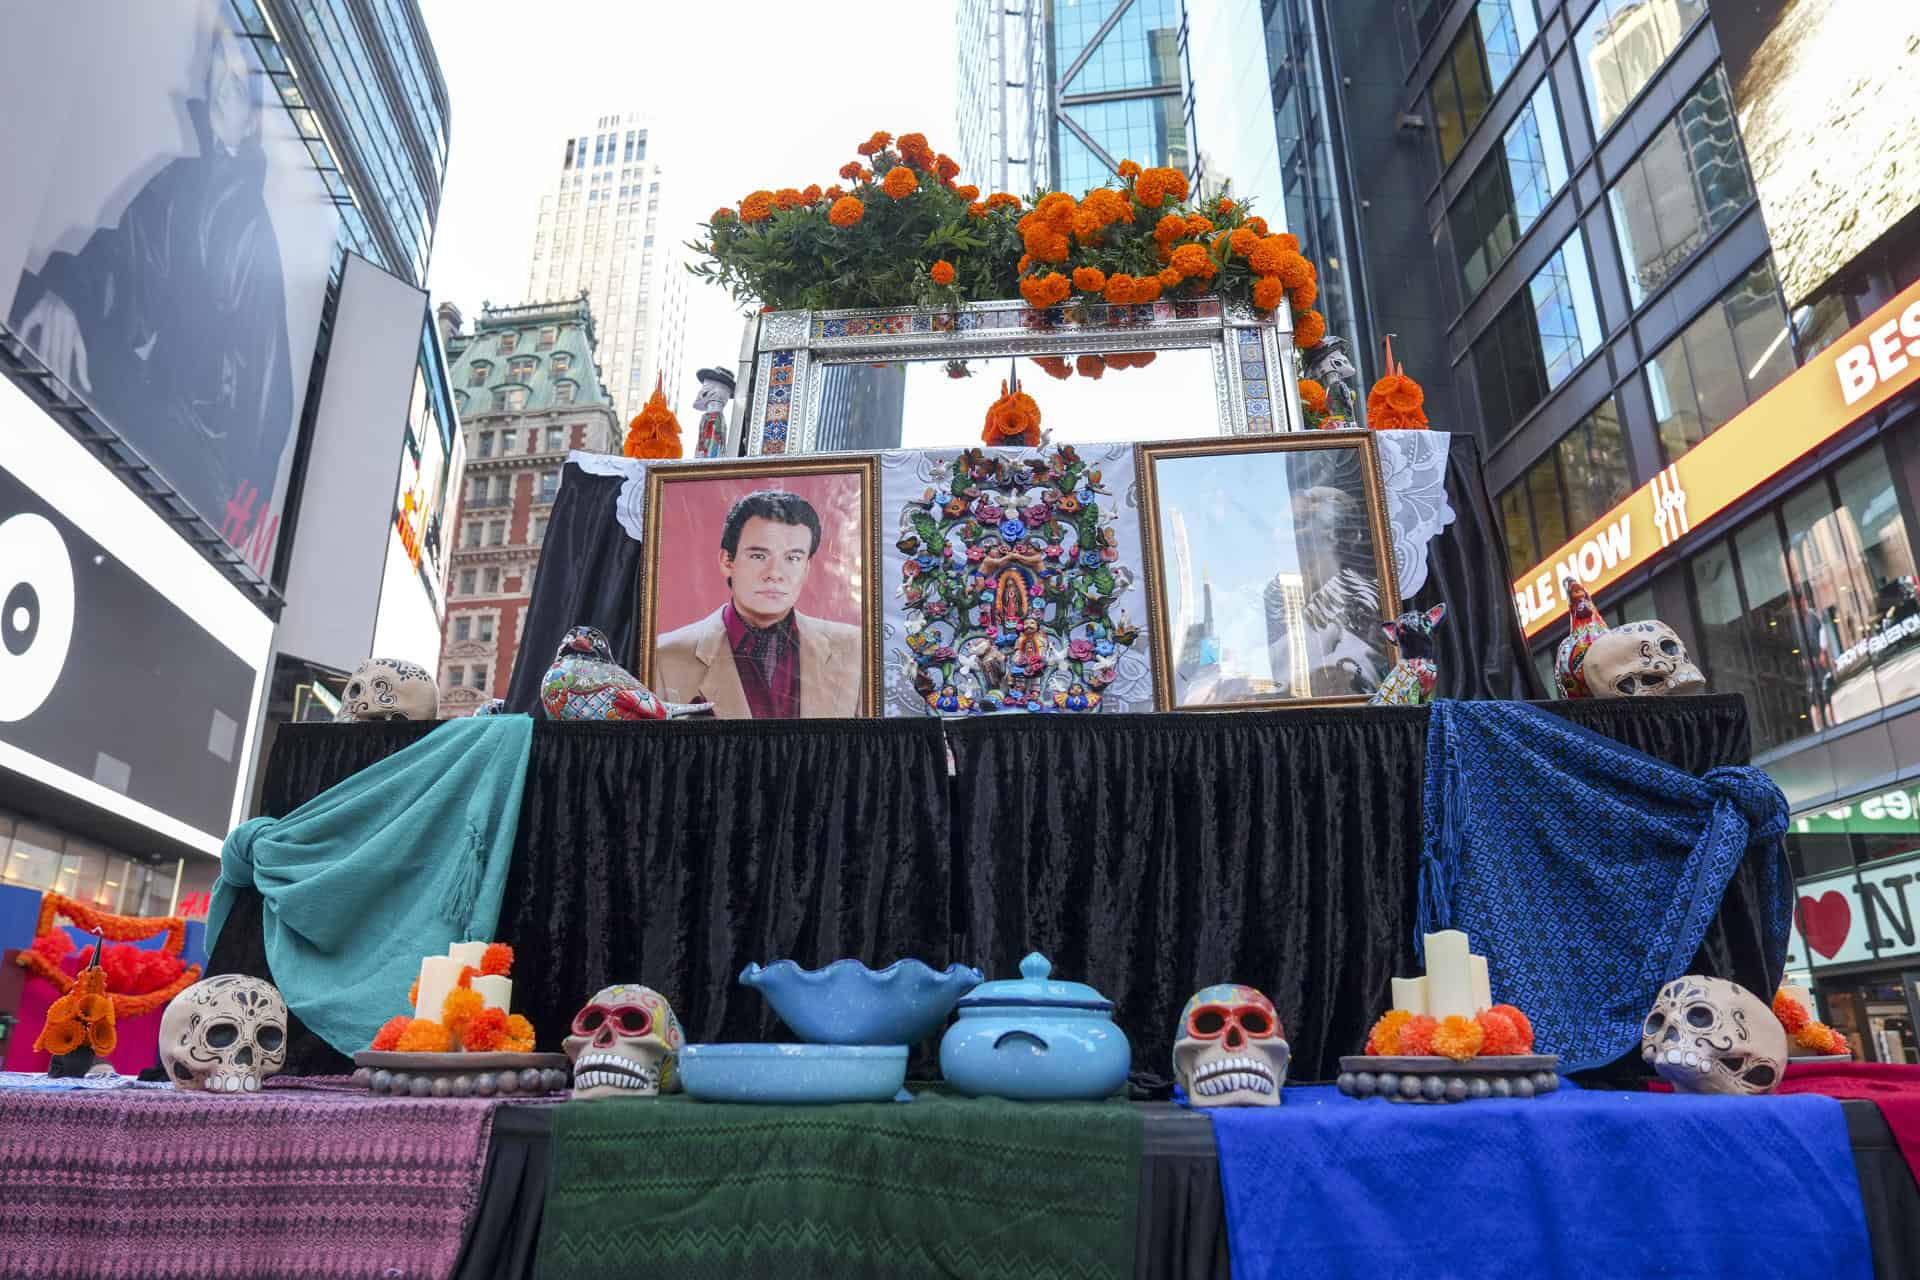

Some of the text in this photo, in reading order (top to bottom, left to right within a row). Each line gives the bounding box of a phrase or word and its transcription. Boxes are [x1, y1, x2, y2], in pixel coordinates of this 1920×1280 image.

[220, 479, 280, 577] H&M
[1555, 513, 1631, 601] NOW
[1852, 871, 1920, 947] N
